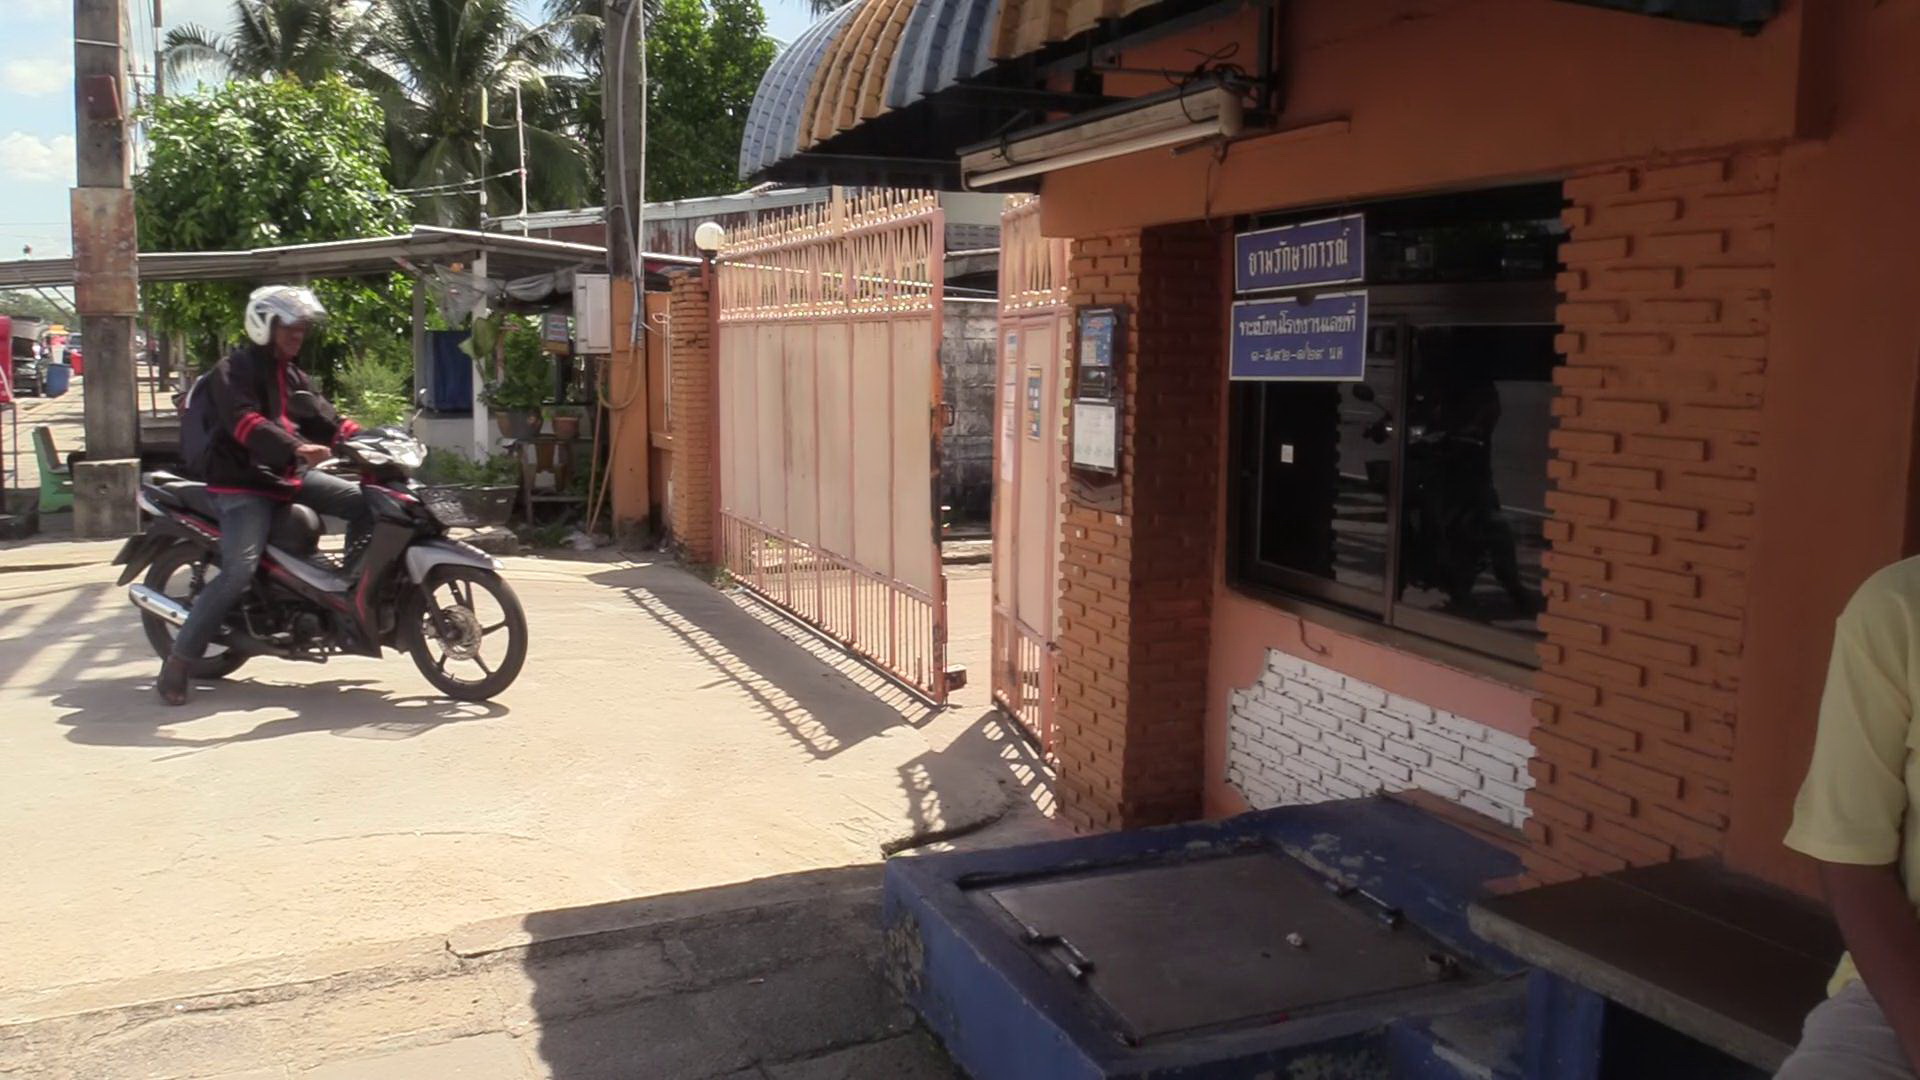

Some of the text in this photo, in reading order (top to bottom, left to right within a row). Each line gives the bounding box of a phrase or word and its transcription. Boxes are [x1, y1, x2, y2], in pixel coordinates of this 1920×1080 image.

[1248, 228, 1350, 277] ยามรักษาการณ์
[1239, 303, 1356, 336] ทะเบียนโรงงานเลขที่
